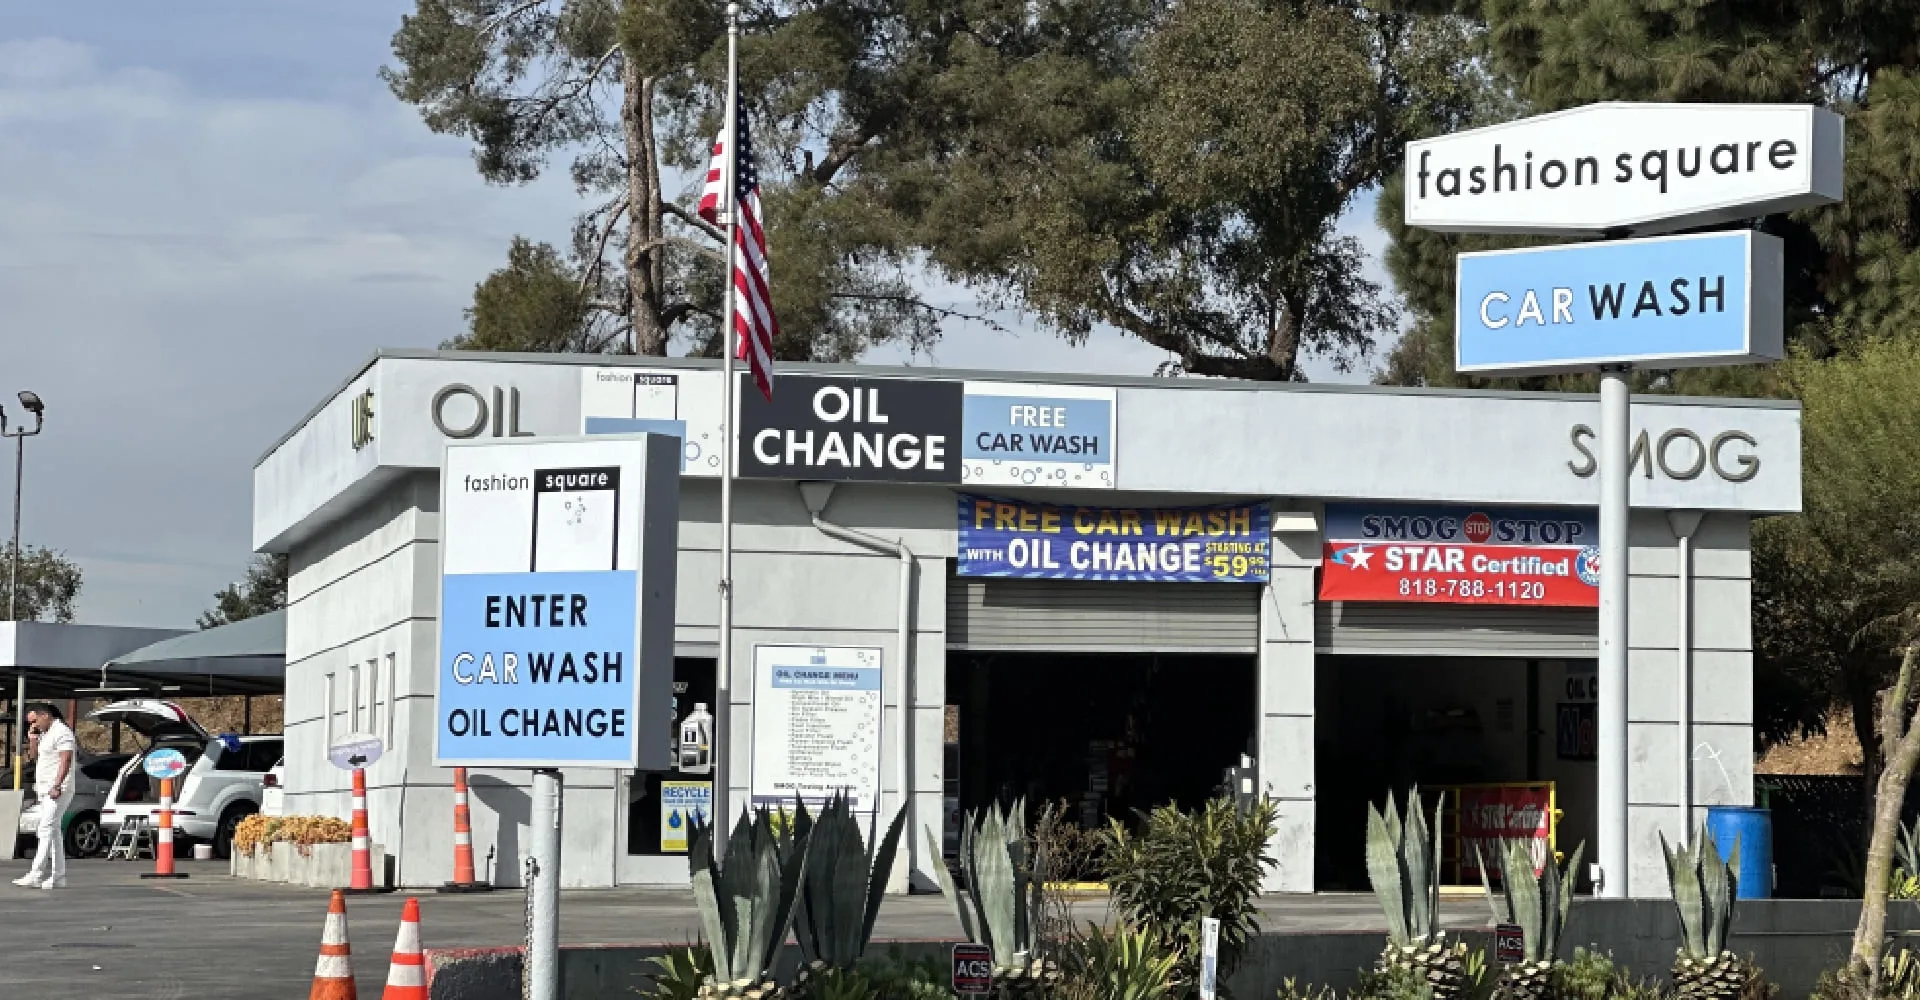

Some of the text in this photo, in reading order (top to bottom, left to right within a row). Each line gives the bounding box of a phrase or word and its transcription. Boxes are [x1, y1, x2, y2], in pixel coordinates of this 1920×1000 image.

[1417, 139, 1798, 199] fashion square
[1480, 275, 1725, 329] CAR WASH
[596, 371, 672, 386] fashion square
[431, 383, 536, 439] OIL
[812, 385, 889, 424] OIL
[1009, 405, 1067, 428] FREE
[752, 428, 946, 471] CHANGE
[976, 431, 1098, 455] CAR WASH
[464, 470, 609, 493] fashion square
[975, 501, 1250, 536] FREE CAR WASH
[1362, 514, 1584, 544] SMOG STOP STOP
[967, 538, 1201, 573] WITH OIL CHANGE
[1205, 542, 1252, 554] STARTING
[1385, 546, 1466, 573] STAR
[1471, 556, 1569, 577] Certified
[1399, 578, 1545, 600] 818-788-1120
[485, 594, 588, 628] ENTER
[453, 651, 623, 685] CAR WASH
[448, 708, 626, 738] OIL CHANGE
[663, 786, 711, 798] RECYCLE
[1498, 936, 1522, 950] ACS
[956, 960, 988, 978] ACS
